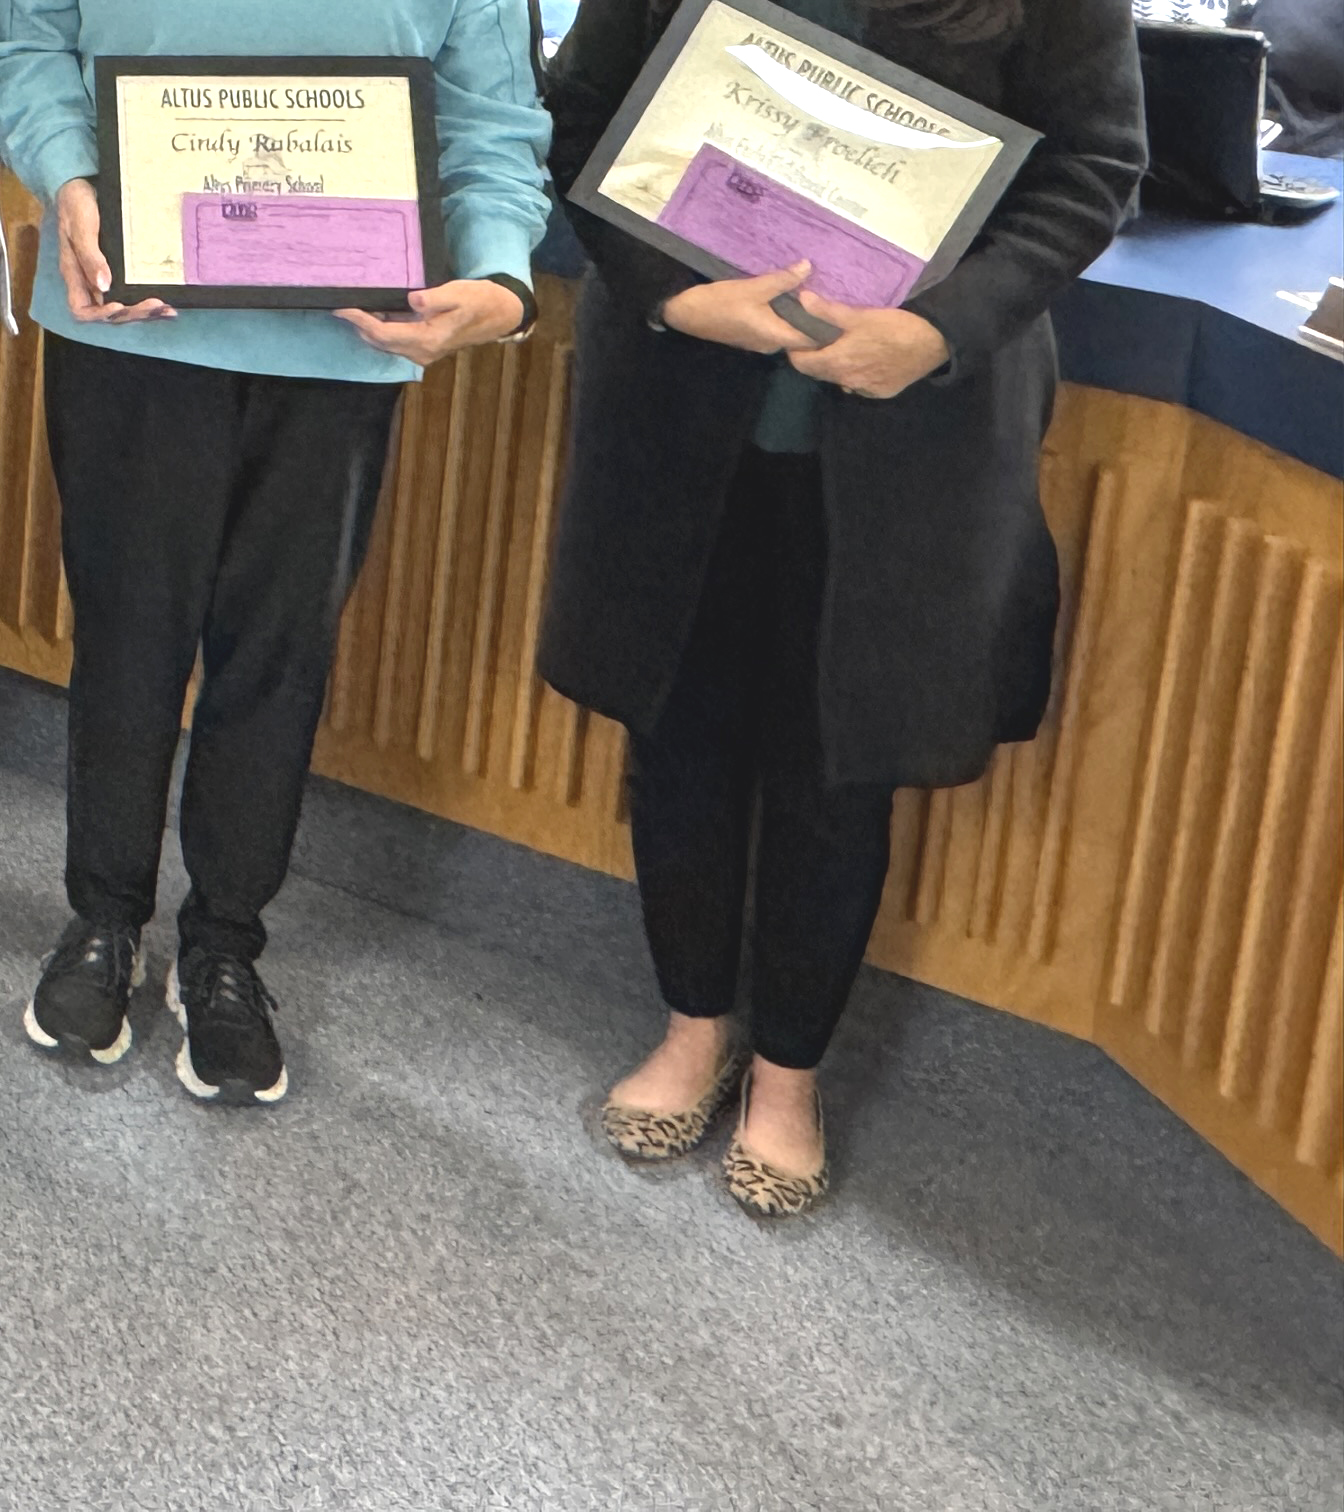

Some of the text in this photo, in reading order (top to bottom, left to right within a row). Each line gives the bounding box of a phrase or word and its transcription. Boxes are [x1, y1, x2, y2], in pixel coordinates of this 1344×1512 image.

[160, 88, 365, 110] ALTUS PUBLIC SCHOOLS
[171, 129, 240, 162] Cindy
